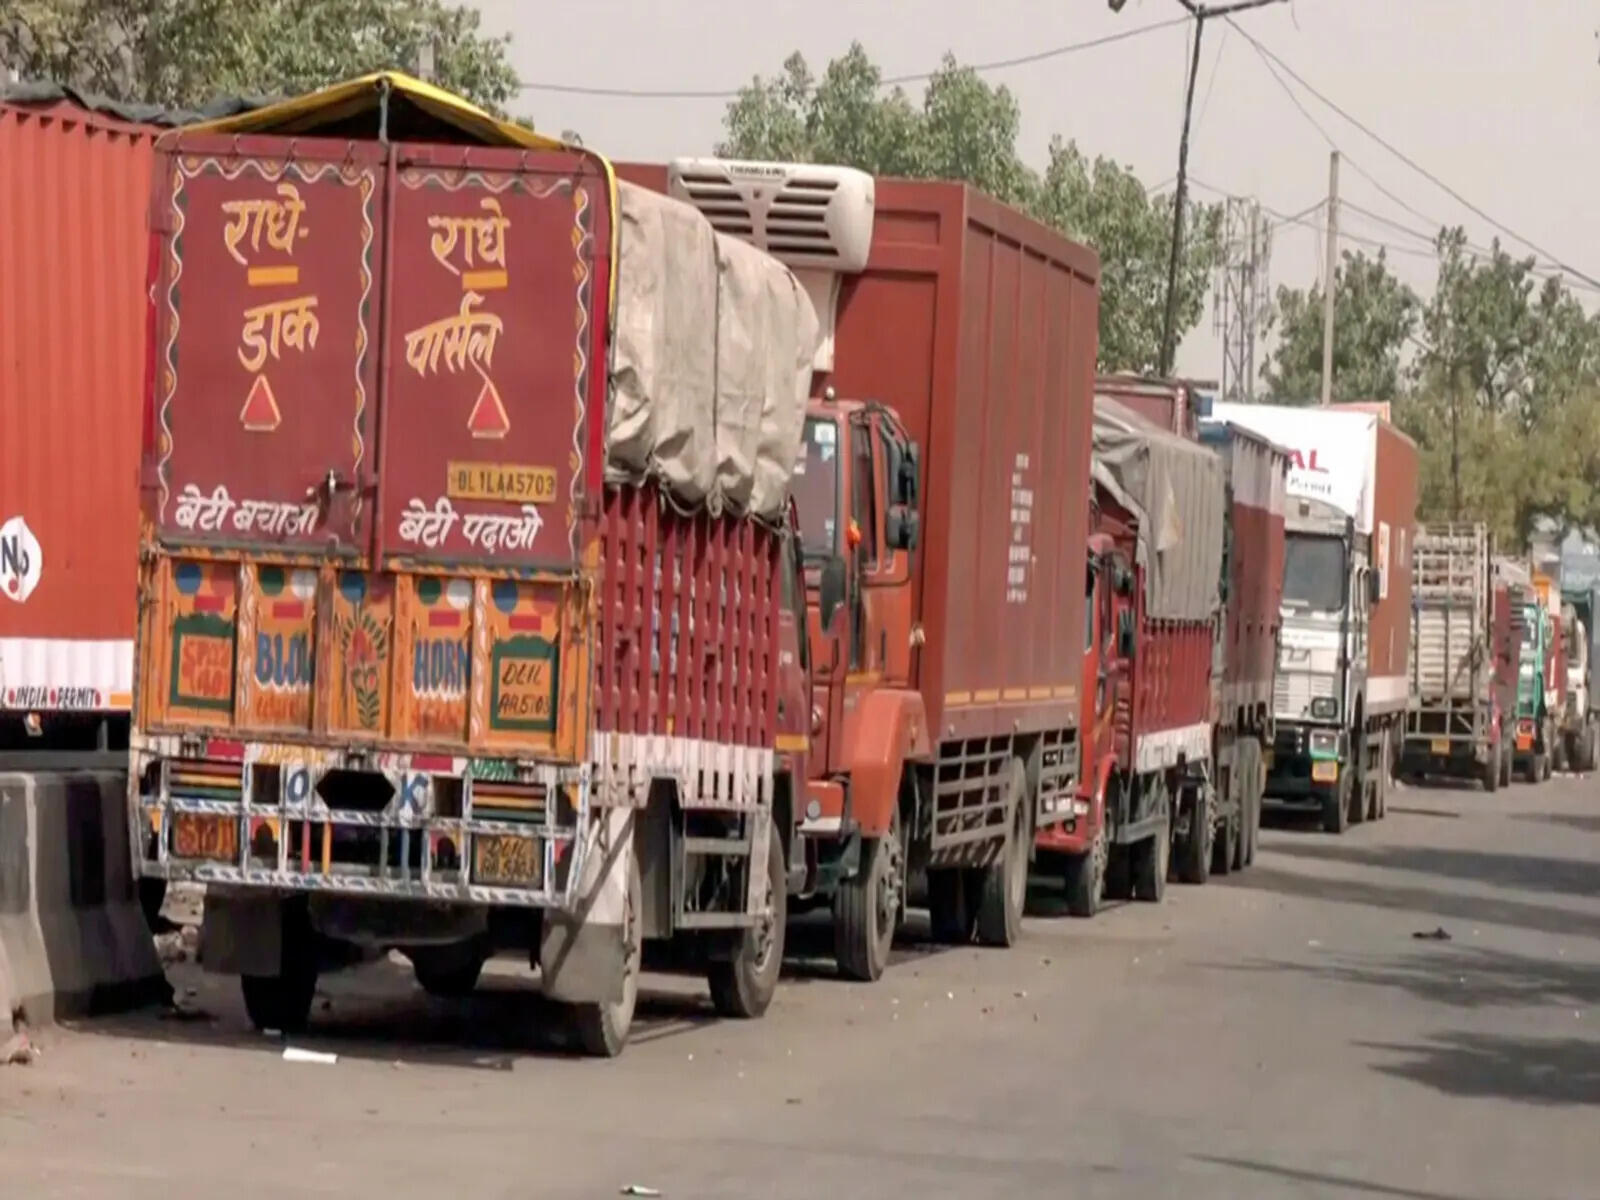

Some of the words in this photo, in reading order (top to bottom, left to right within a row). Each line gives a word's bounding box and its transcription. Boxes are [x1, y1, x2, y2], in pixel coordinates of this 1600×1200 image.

[427, 196, 511, 276] राधे
[237, 295, 319, 372] डाक
[175, 483, 237, 532] बेटी
[398, 496, 460, 548] बेटी
[15, 686, 48, 708] INDIA
[57, 686, 96, 709] PERMIT
